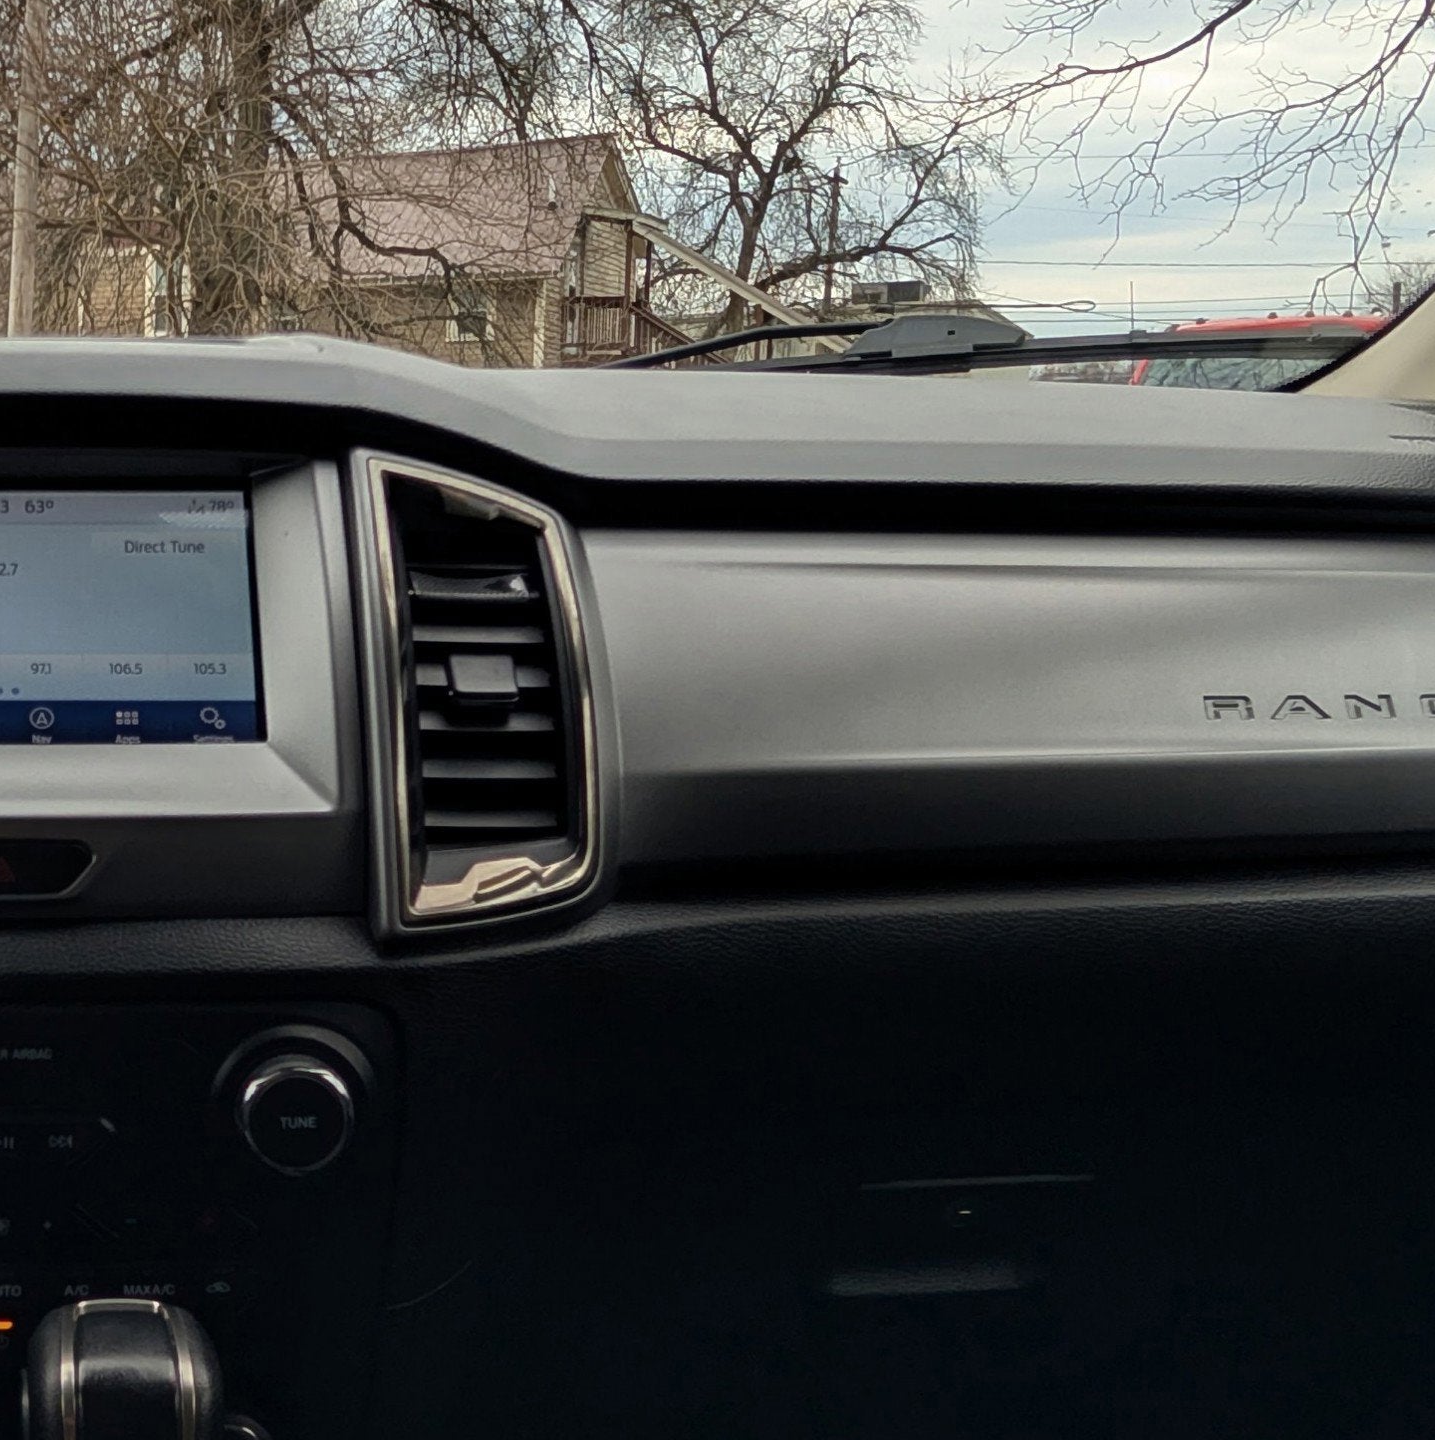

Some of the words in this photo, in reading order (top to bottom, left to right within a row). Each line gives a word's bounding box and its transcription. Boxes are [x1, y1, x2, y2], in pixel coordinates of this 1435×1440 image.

[124, 540, 166, 554] Direct
[171, 540, 205, 554] Tune
[109, 662, 143, 675] 106.5
[193, 662, 227, 675] 105.3
[32, 734, 52, 744] Nav
[12, 1048, 53, 1061] AIRBAG
[279, 1115, 318, 1131] TUNE
[64, 1284, 90, 1297] A/C
